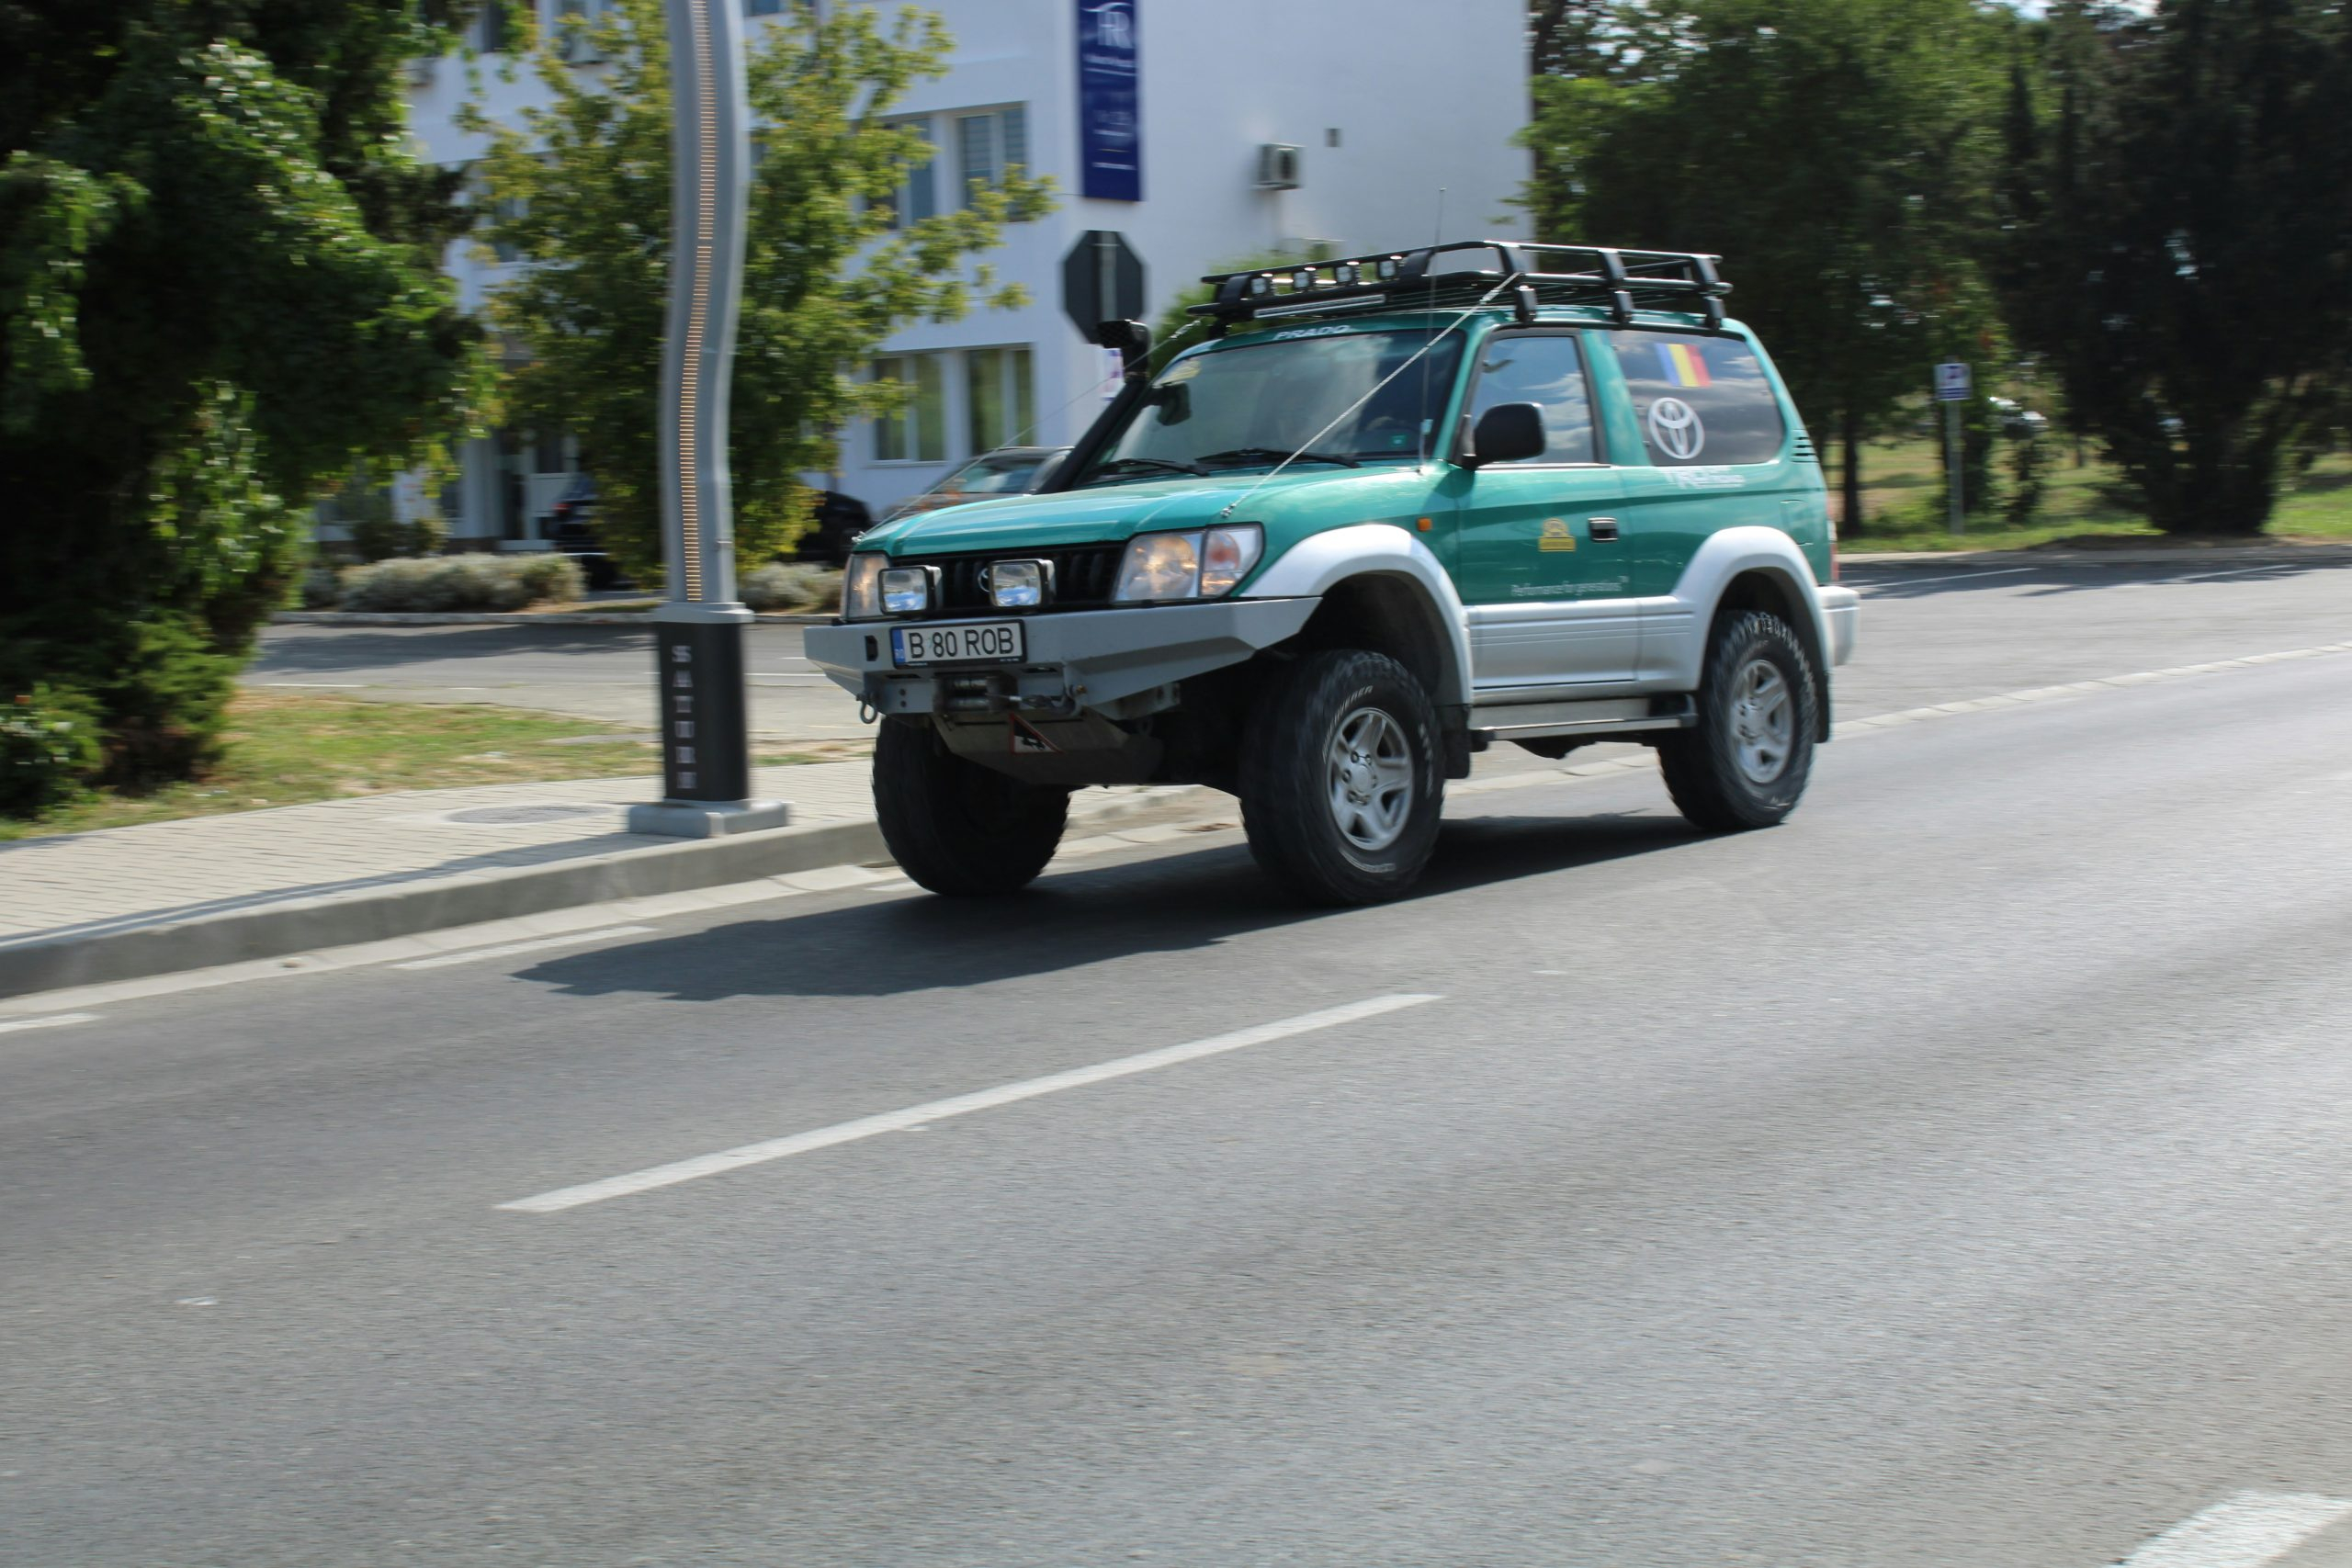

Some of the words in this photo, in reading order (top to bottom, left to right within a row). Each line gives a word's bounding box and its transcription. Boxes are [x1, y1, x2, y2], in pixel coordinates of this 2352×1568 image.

[1272, 324, 1351, 341] PRADO
[908, 632, 925, 659] B
[932, 631, 957, 658] 80
[964, 627, 1014, 656] ROB
